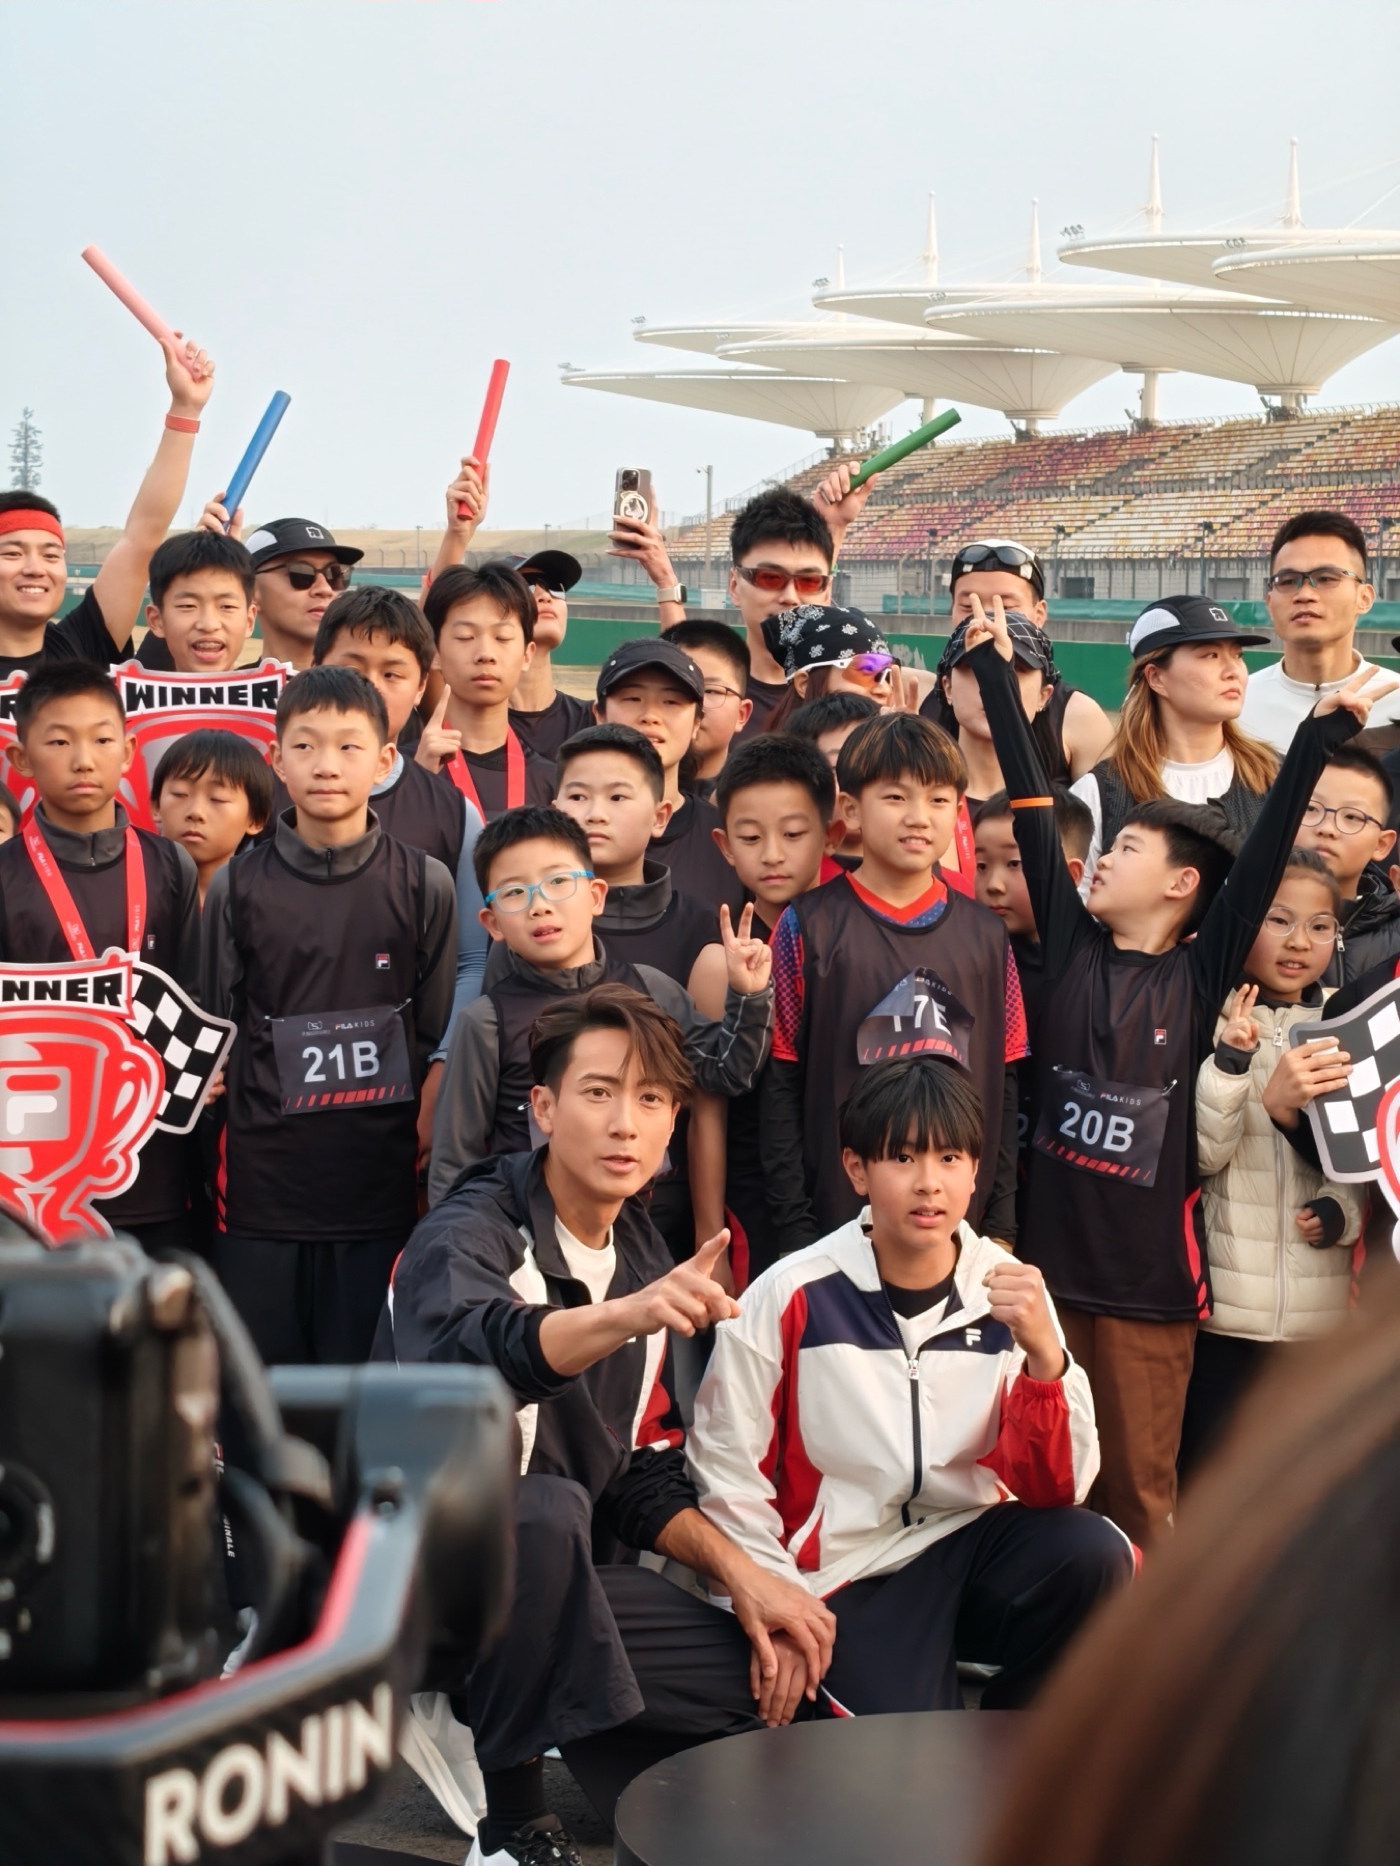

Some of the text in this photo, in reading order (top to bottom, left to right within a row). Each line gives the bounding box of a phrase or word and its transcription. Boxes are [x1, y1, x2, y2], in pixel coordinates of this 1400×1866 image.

[126, 680, 279, 712] WINNER
[335, 1022, 353, 1030] FILA
[354, 1020, 375, 1028] KIDS
[302, 1040, 380, 1083] 21B
[1100, 1092, 1142, 1106] FILA KIDS
[1059, 1101, 1135, 1153] 20B
[144, 1681, 392, 1866] RONIN
